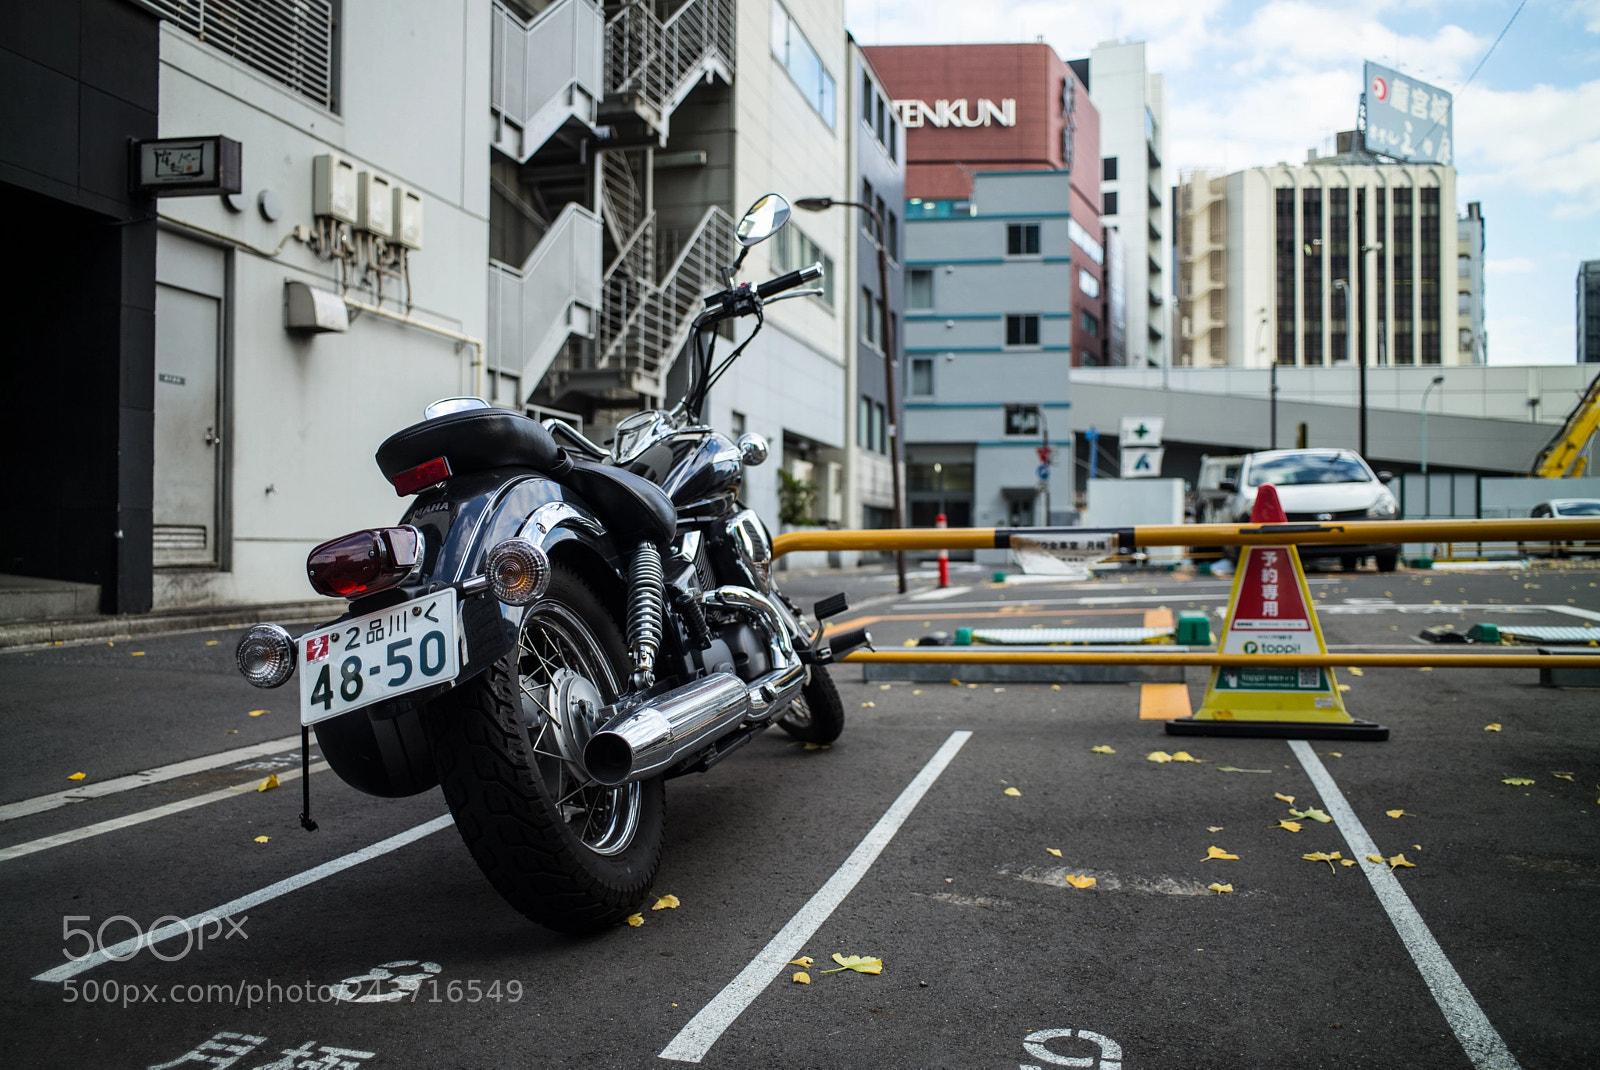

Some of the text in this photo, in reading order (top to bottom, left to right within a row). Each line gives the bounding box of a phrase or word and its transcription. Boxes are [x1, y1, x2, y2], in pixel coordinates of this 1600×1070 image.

[1261, 551, 1279, 617] 予約専用
[310, 630, 446, 711] 48-50
